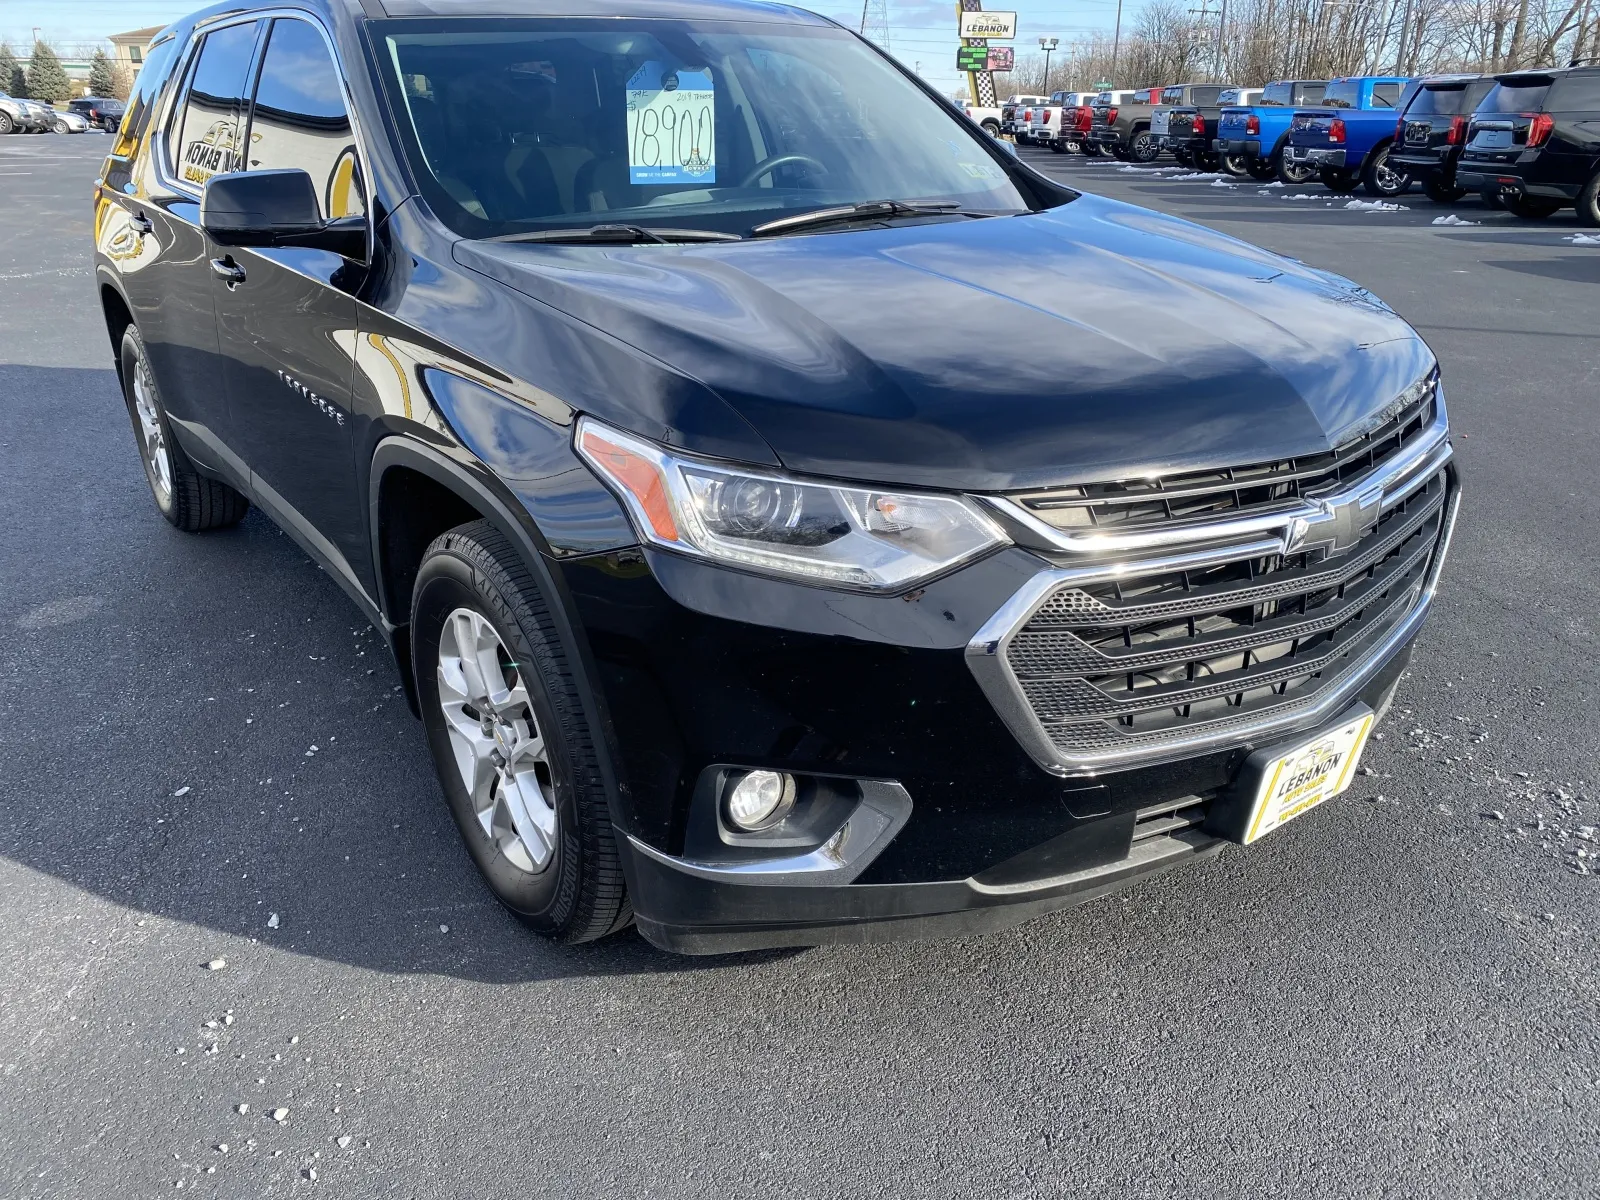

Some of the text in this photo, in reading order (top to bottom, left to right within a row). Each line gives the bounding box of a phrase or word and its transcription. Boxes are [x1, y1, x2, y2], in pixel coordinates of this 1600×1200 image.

[278, 369, 345, 426] TRAVERSE
[478, 578, 523, 647] ALENZA
[1277, 752, 1342, 798] LEBANON
[549, 829, 580, 926] BRIDGESTONE
